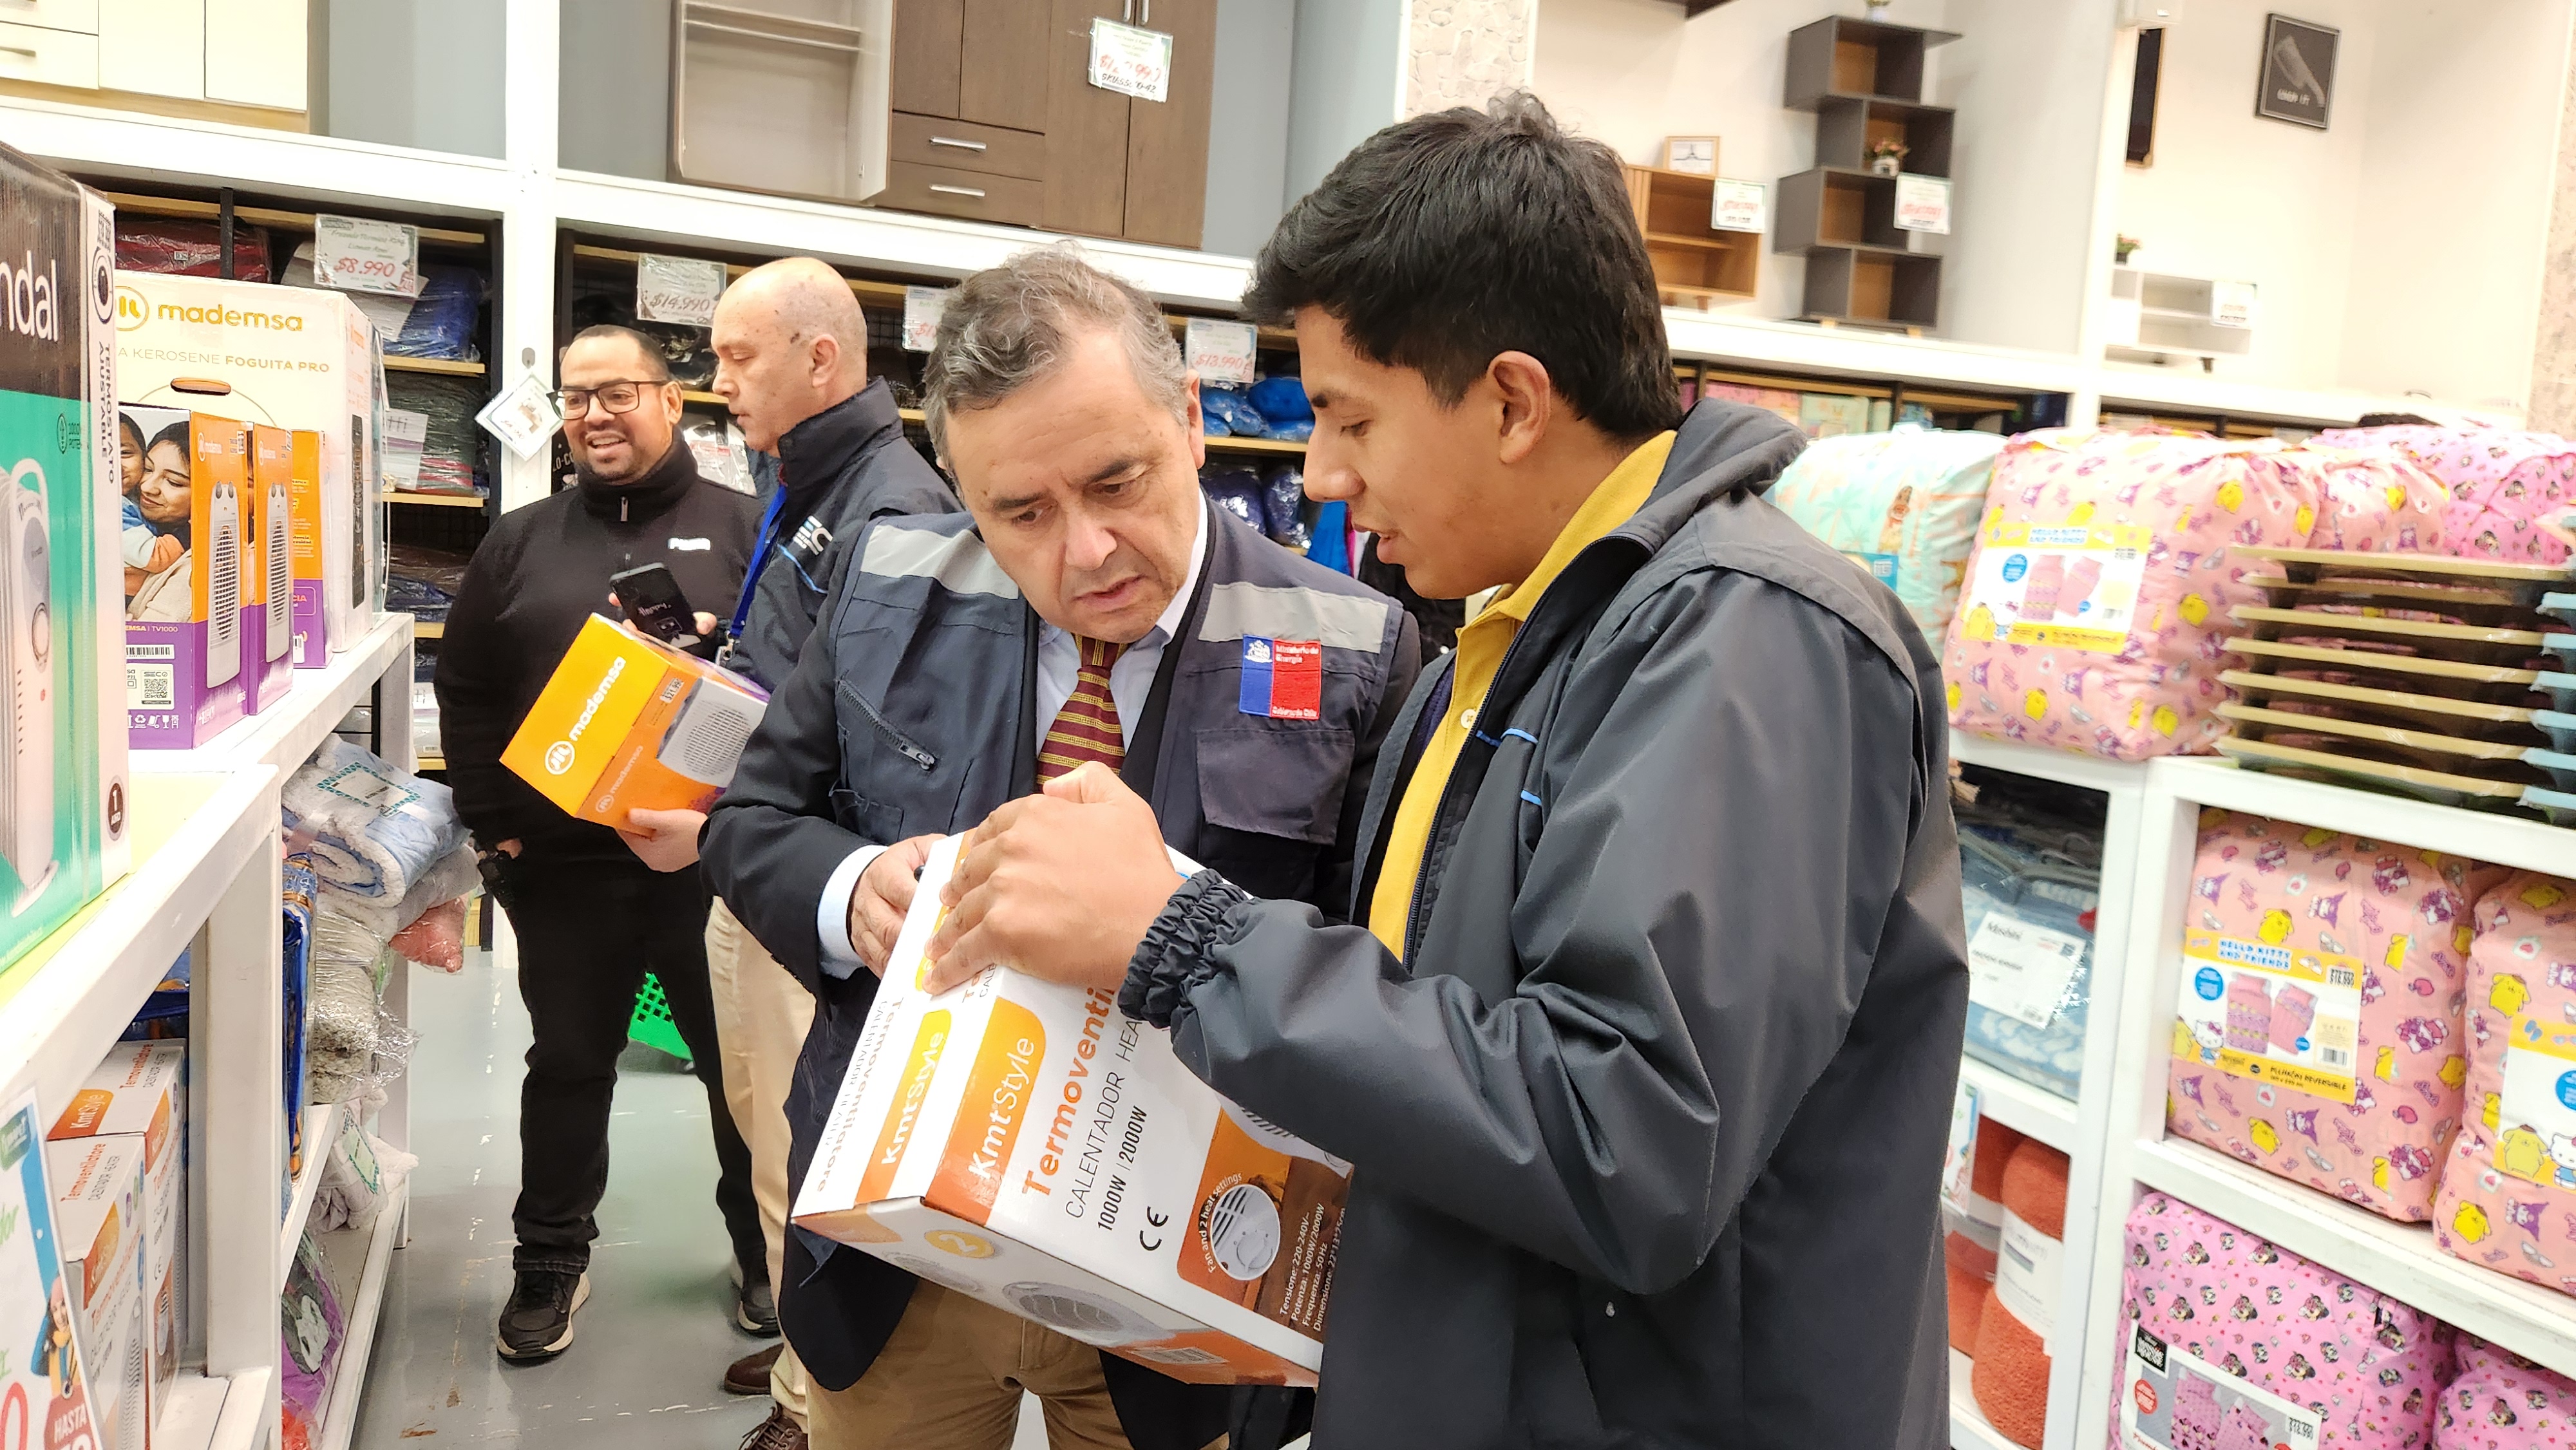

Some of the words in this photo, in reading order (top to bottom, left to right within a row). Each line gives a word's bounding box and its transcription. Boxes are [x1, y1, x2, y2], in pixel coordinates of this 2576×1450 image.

[334, 257, 395, 278] $8.990
[649, 293, 710, 312] $14.990
[158, 303, 303, 332] mademsa
[133, 348, 221, 365] KEROSENE
[225, 355, 294, 371] FOGUITA
[298, 361, 330, 373] PRO
[99, 341, 108, 458] AJUSTABLE
[104, 343, 115, 484] TERMOSTATO
[569, 656, 627, 742] mademsa
[609, 744, 643, 795] mademsa
[817, 997, 905, 1193] Termoventilatore
[1065, 1071, 1126, 1218] CALENTADOR
[1098, 1173, 1126, 1231] 1000W
[1119, 1105, 1148, 1165] 2000W
[1213, 1172, 1243, 1197] settings
[1200, 1194, 1216, 1219] heat
[1199, 1219, 1208, 1229] 2
[1198, 1230, 1210, 1252] and
[1319, 1242, 1329, 1258] Hz
[1204, 1251, 1217, 1274] Fan
[1291, 1274, 1309, 1322] Potenza:
[1302, 1202, 1325, 1276] 1000W/2000W
[1316, 1258, 1325, 1271] 50
[1302, 1270, 1322, 1327] Frequenza:
[53, 1402, 89, 1444] HASTA
